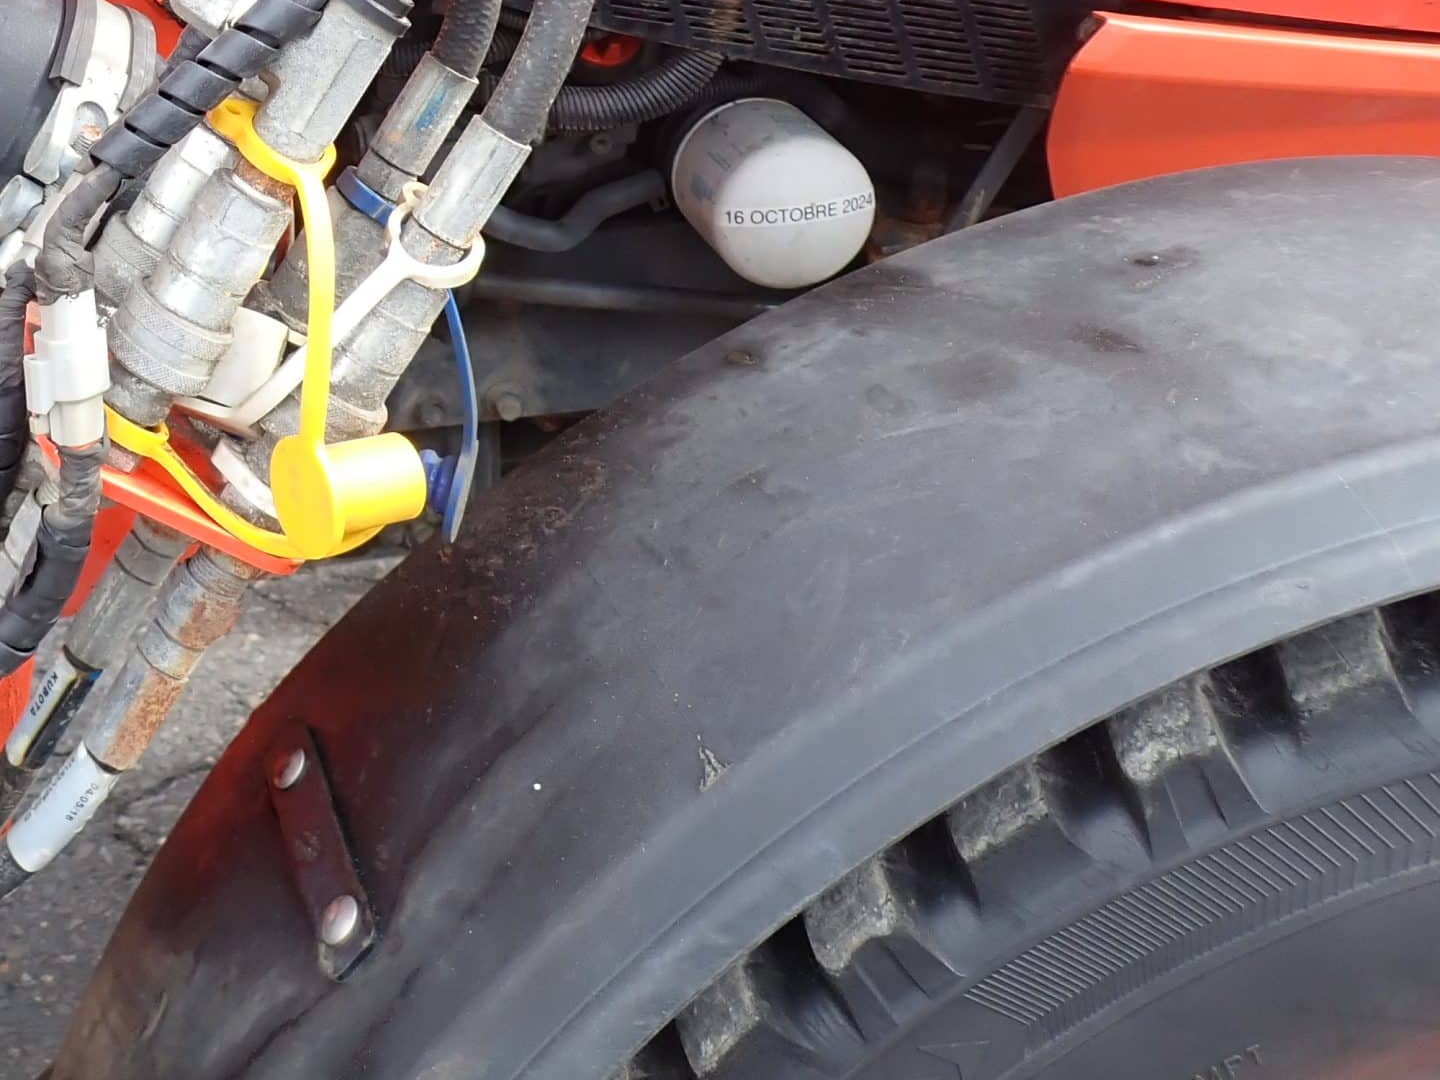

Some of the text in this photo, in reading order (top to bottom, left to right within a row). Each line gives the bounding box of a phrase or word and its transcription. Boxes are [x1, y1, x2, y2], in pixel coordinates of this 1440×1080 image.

[725, 192, 873, 224] 16 OCTOBRE 2024
